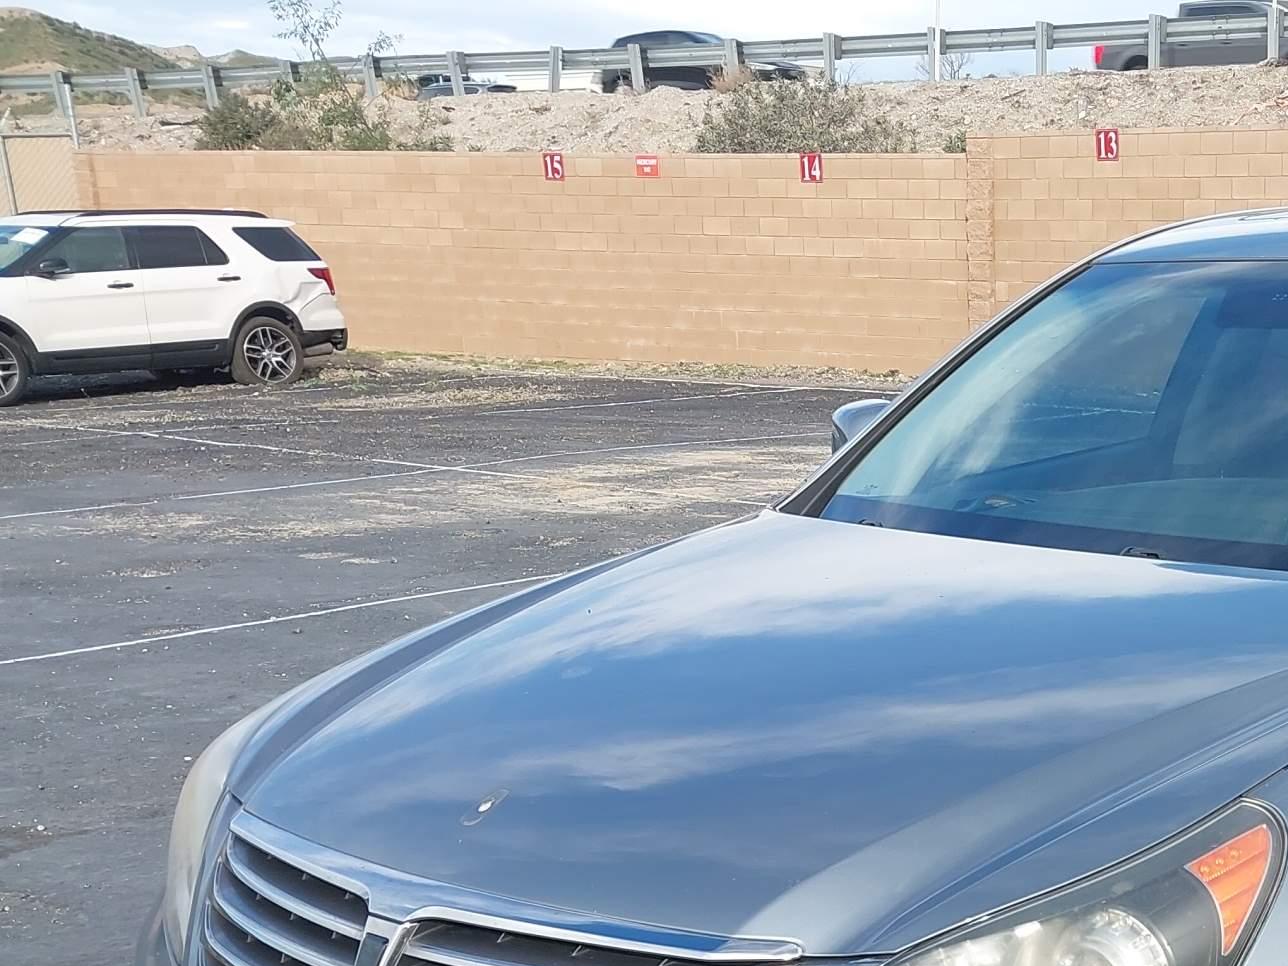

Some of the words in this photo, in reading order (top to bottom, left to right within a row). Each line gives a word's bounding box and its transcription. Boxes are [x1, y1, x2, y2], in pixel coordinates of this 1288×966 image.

[1098, 131, 1117, 159] 13
[544, 155, 562, 179] 15
[802, 155, 820, 181] 14
